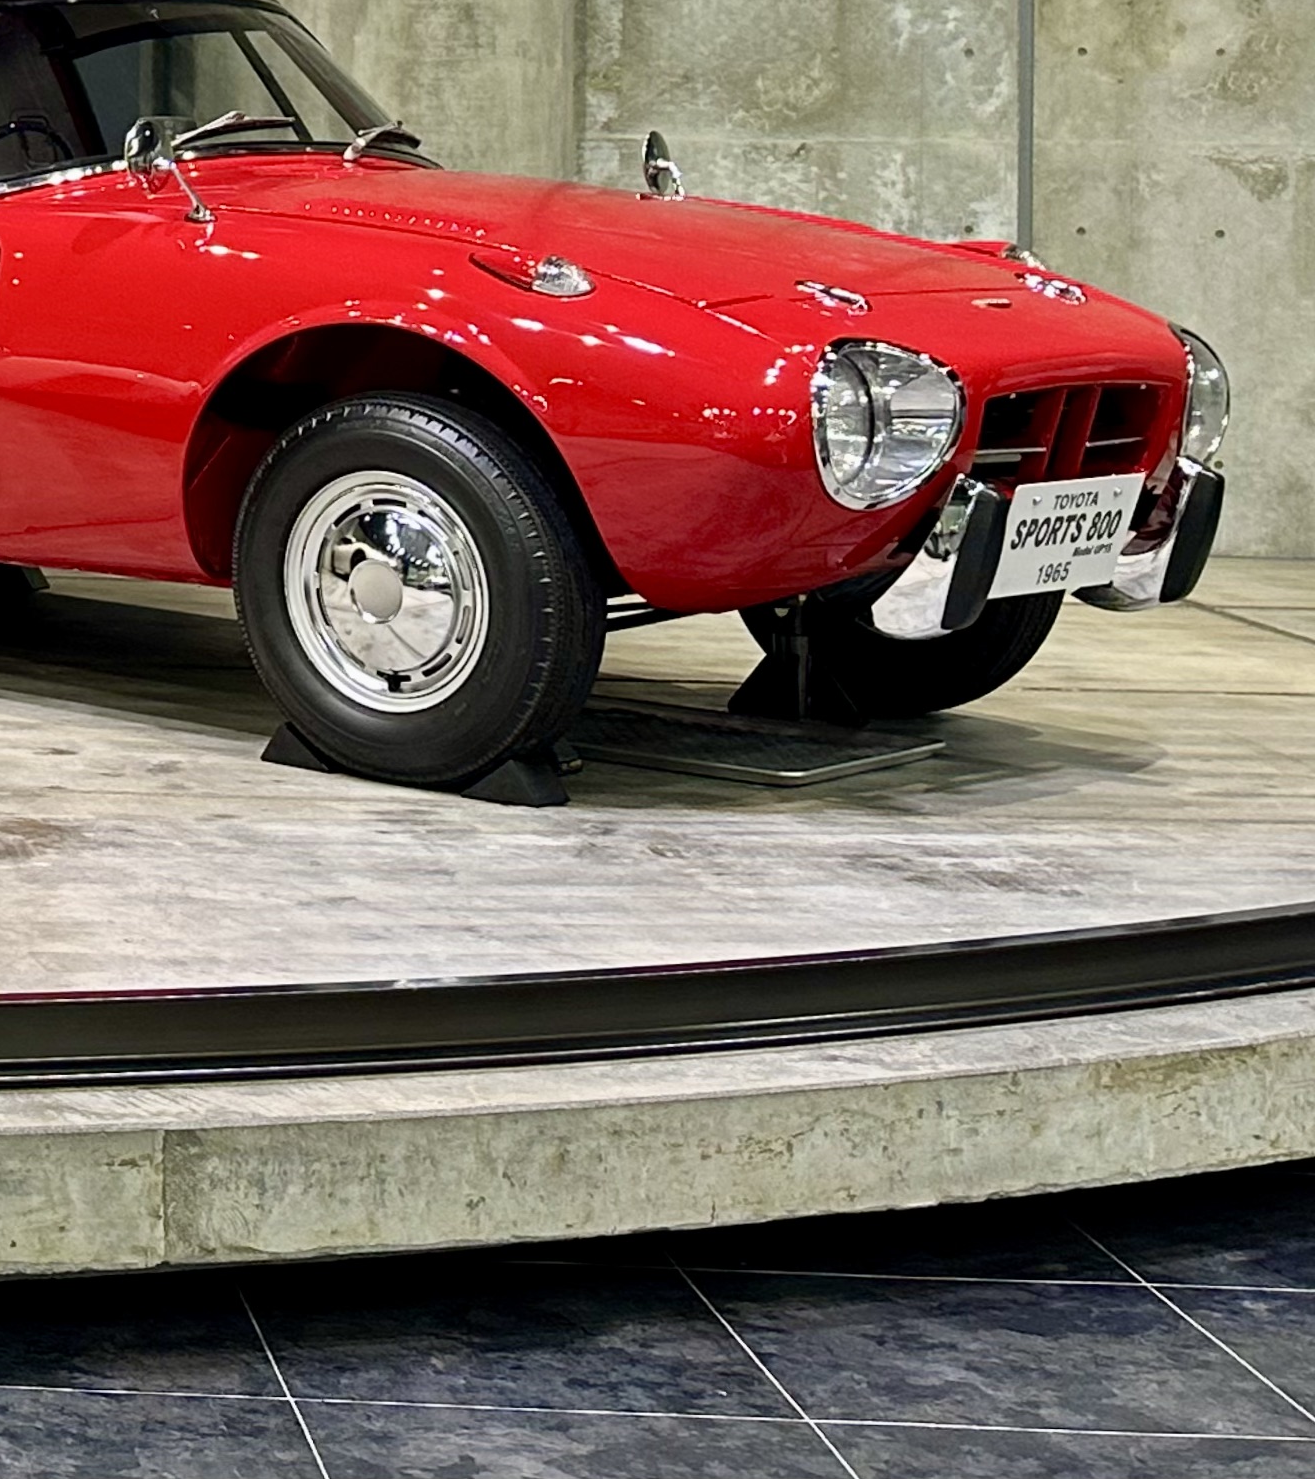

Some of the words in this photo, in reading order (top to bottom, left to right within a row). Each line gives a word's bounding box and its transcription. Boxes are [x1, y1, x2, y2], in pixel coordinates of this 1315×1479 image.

[1053, 491, 1099, 510] TOYOTA
[1010, 512, 1087, 550] SPORTS
[1086, 509, 1123, 542] 800
[1035, 561, 1073, 585] 1965
